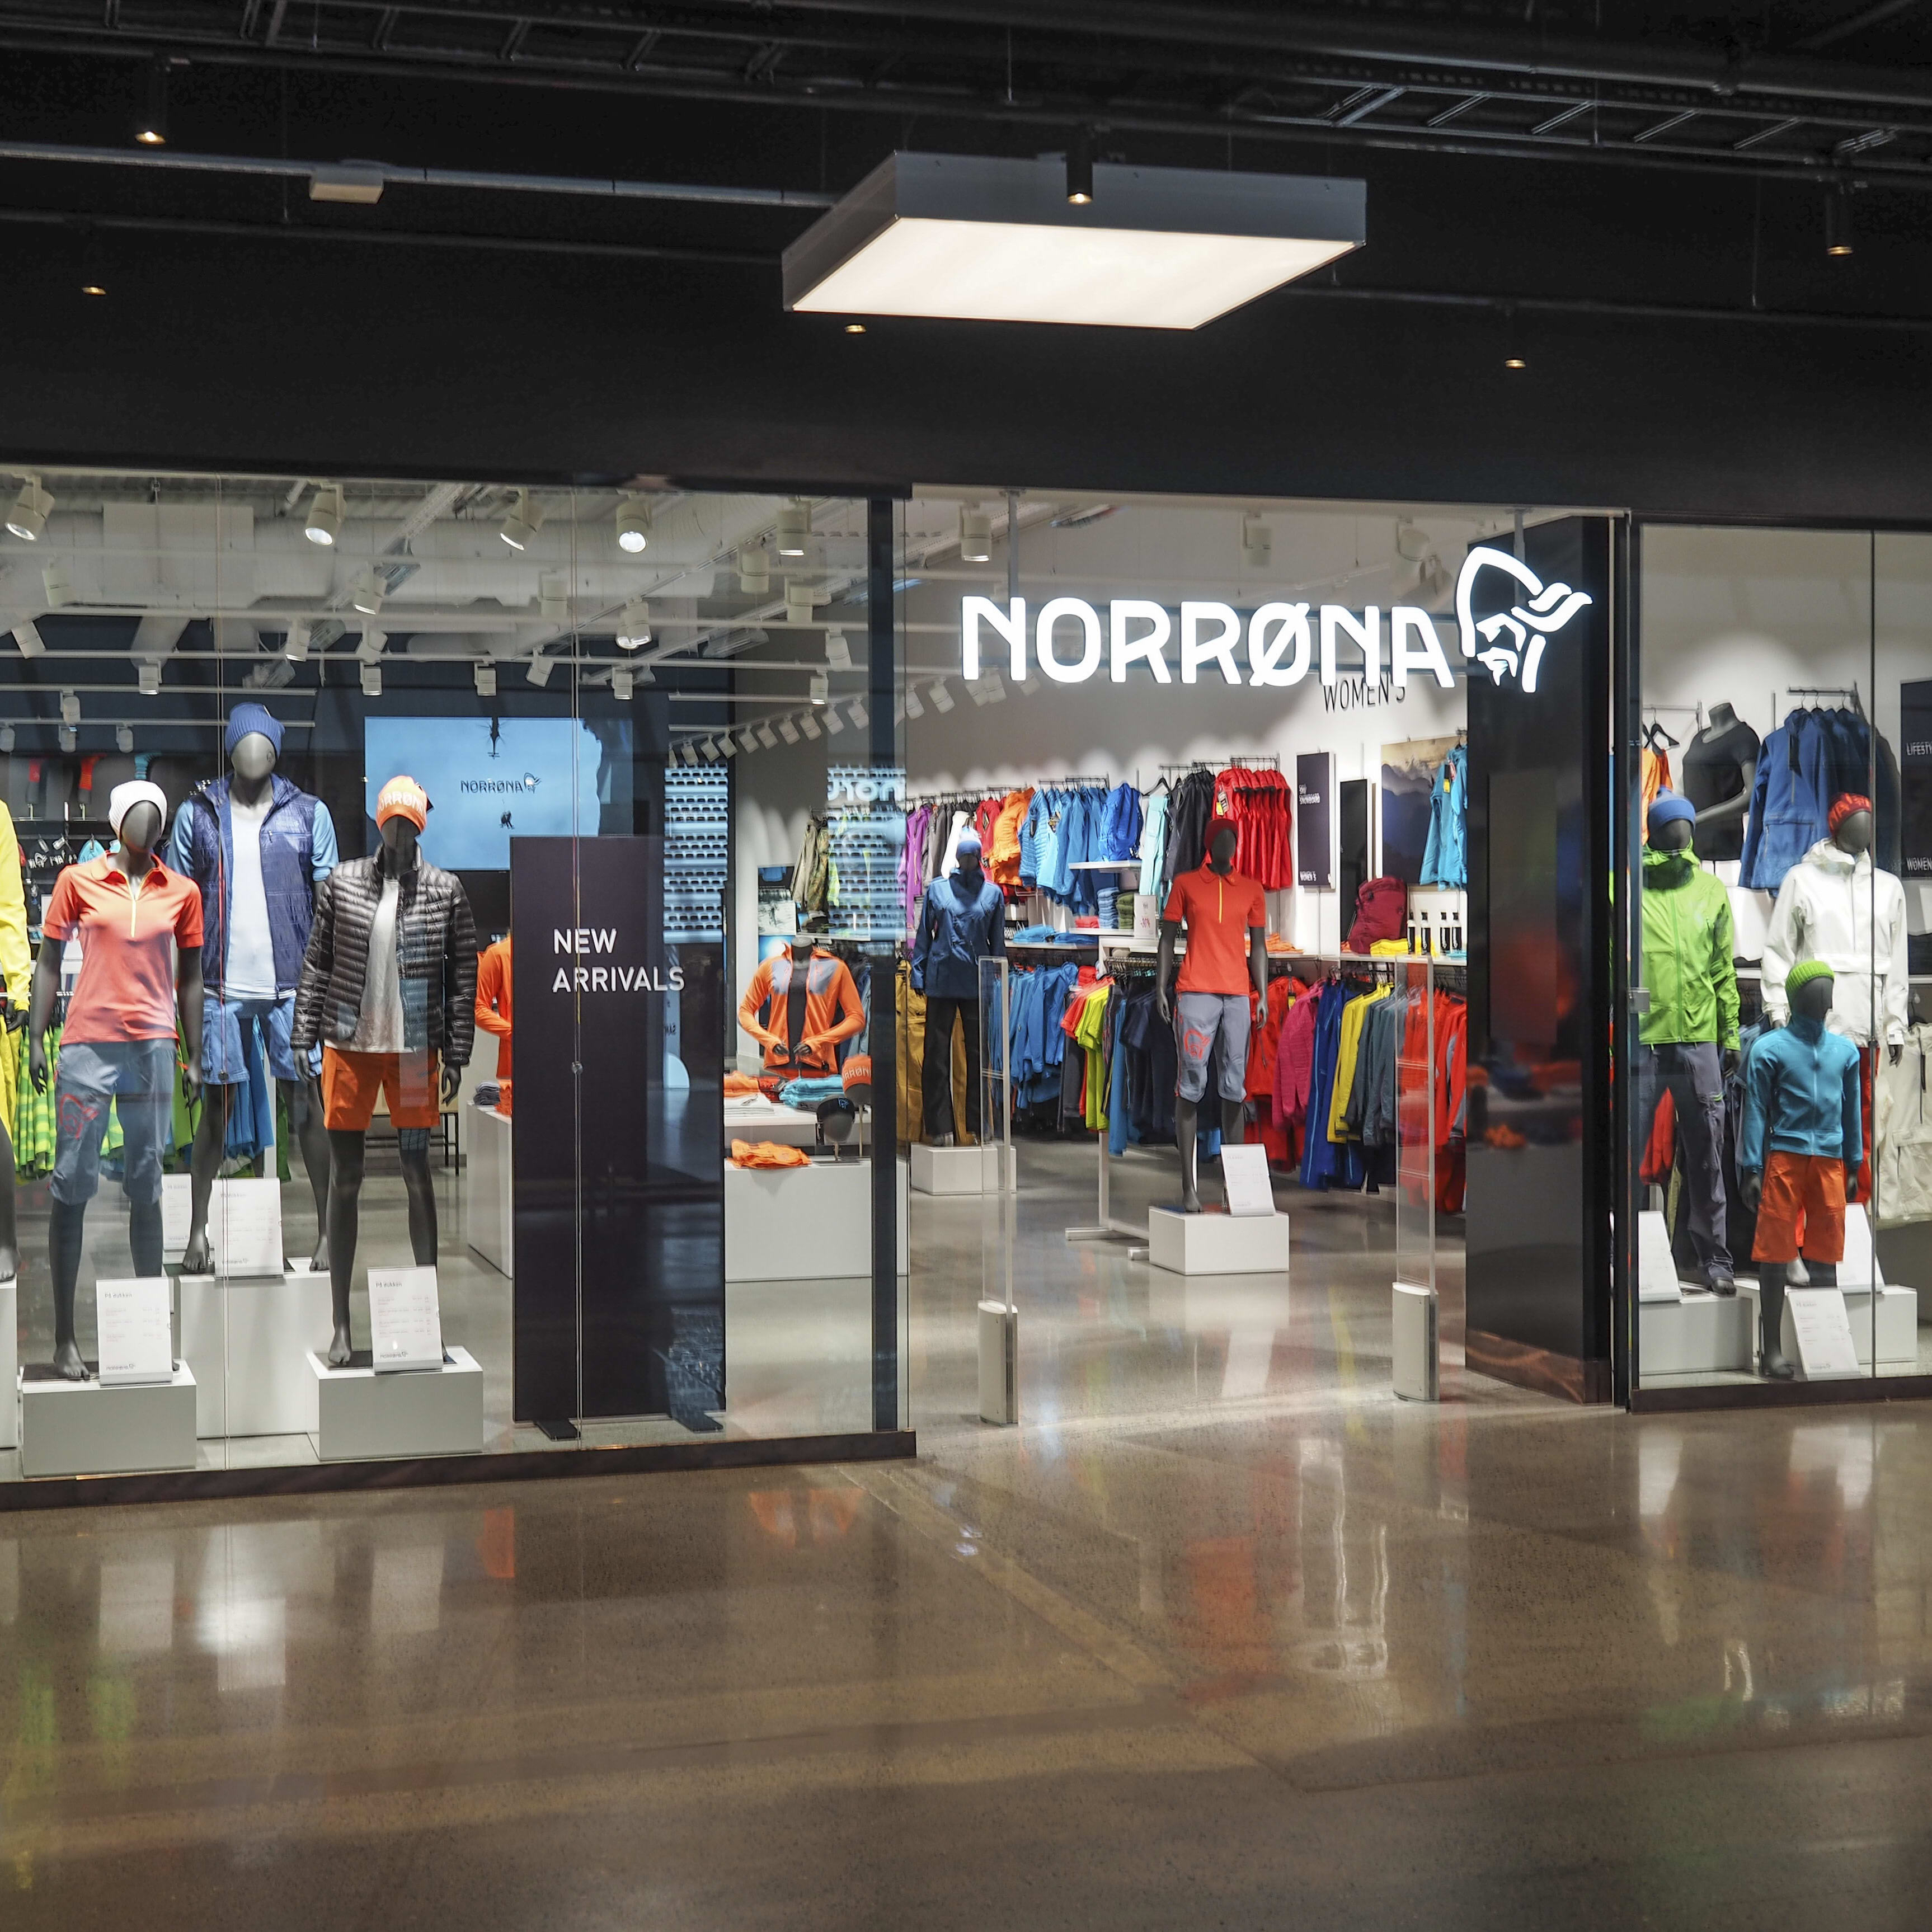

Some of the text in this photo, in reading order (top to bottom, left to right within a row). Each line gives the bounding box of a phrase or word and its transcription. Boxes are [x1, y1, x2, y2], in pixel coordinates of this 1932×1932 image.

[962, 595, 1455, 688] NORRØNA
[1323, 671, 1405, 713] WOMENS
[460, 780, 524, 793] NORRØNA
[553, 928, 617, 954] NEW
[552, 966, 685, 993] ARRIVALS
